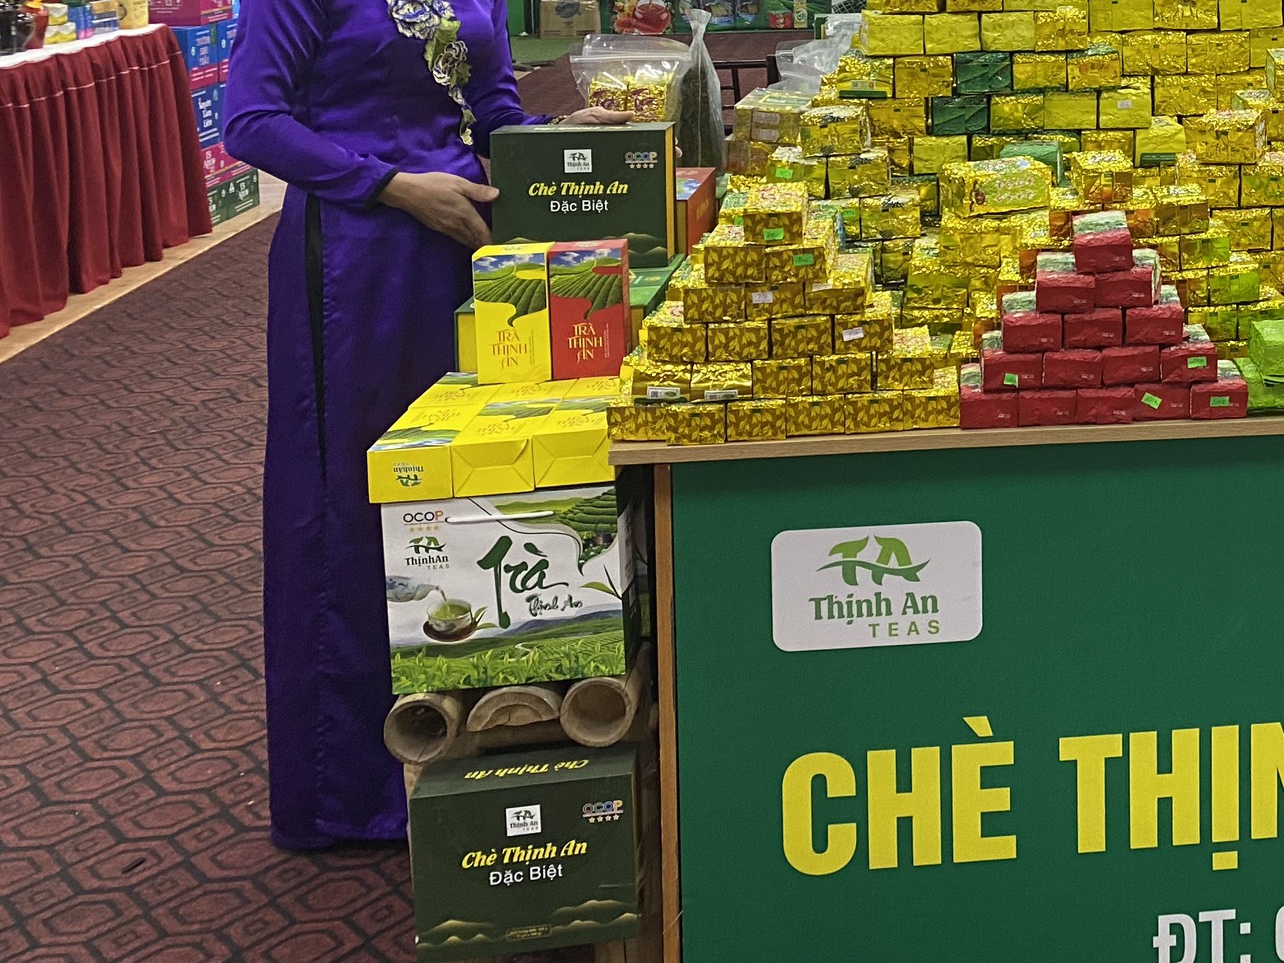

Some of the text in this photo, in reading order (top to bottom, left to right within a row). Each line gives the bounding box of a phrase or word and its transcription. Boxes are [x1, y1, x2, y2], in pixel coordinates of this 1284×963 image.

[625, 152, 657, 161] OCOP
[528, 181, 628, 199] Chè Thịnh An
[550, 200, 609, 214] Đặc Biệt
[573, 323, 596, 335] TRÀ
[403, 510, 444, 524] OCOP
[404, 554, 450, 567] ThịnhAn
[476, 535, 569, 629] Trà
[808, 592, 939, 625] Thịnh An
[868, 620, 940, 638] TEAS
[781, 716, 1018, 877] CHÈ
[582, 799, 623, 814] OCOP
[461, 839, 588, 869] Chè Thịnh An
[489, 864, 563, 887] Đặc Biệt
[1153, 908, 1251, 963] ĐT:
